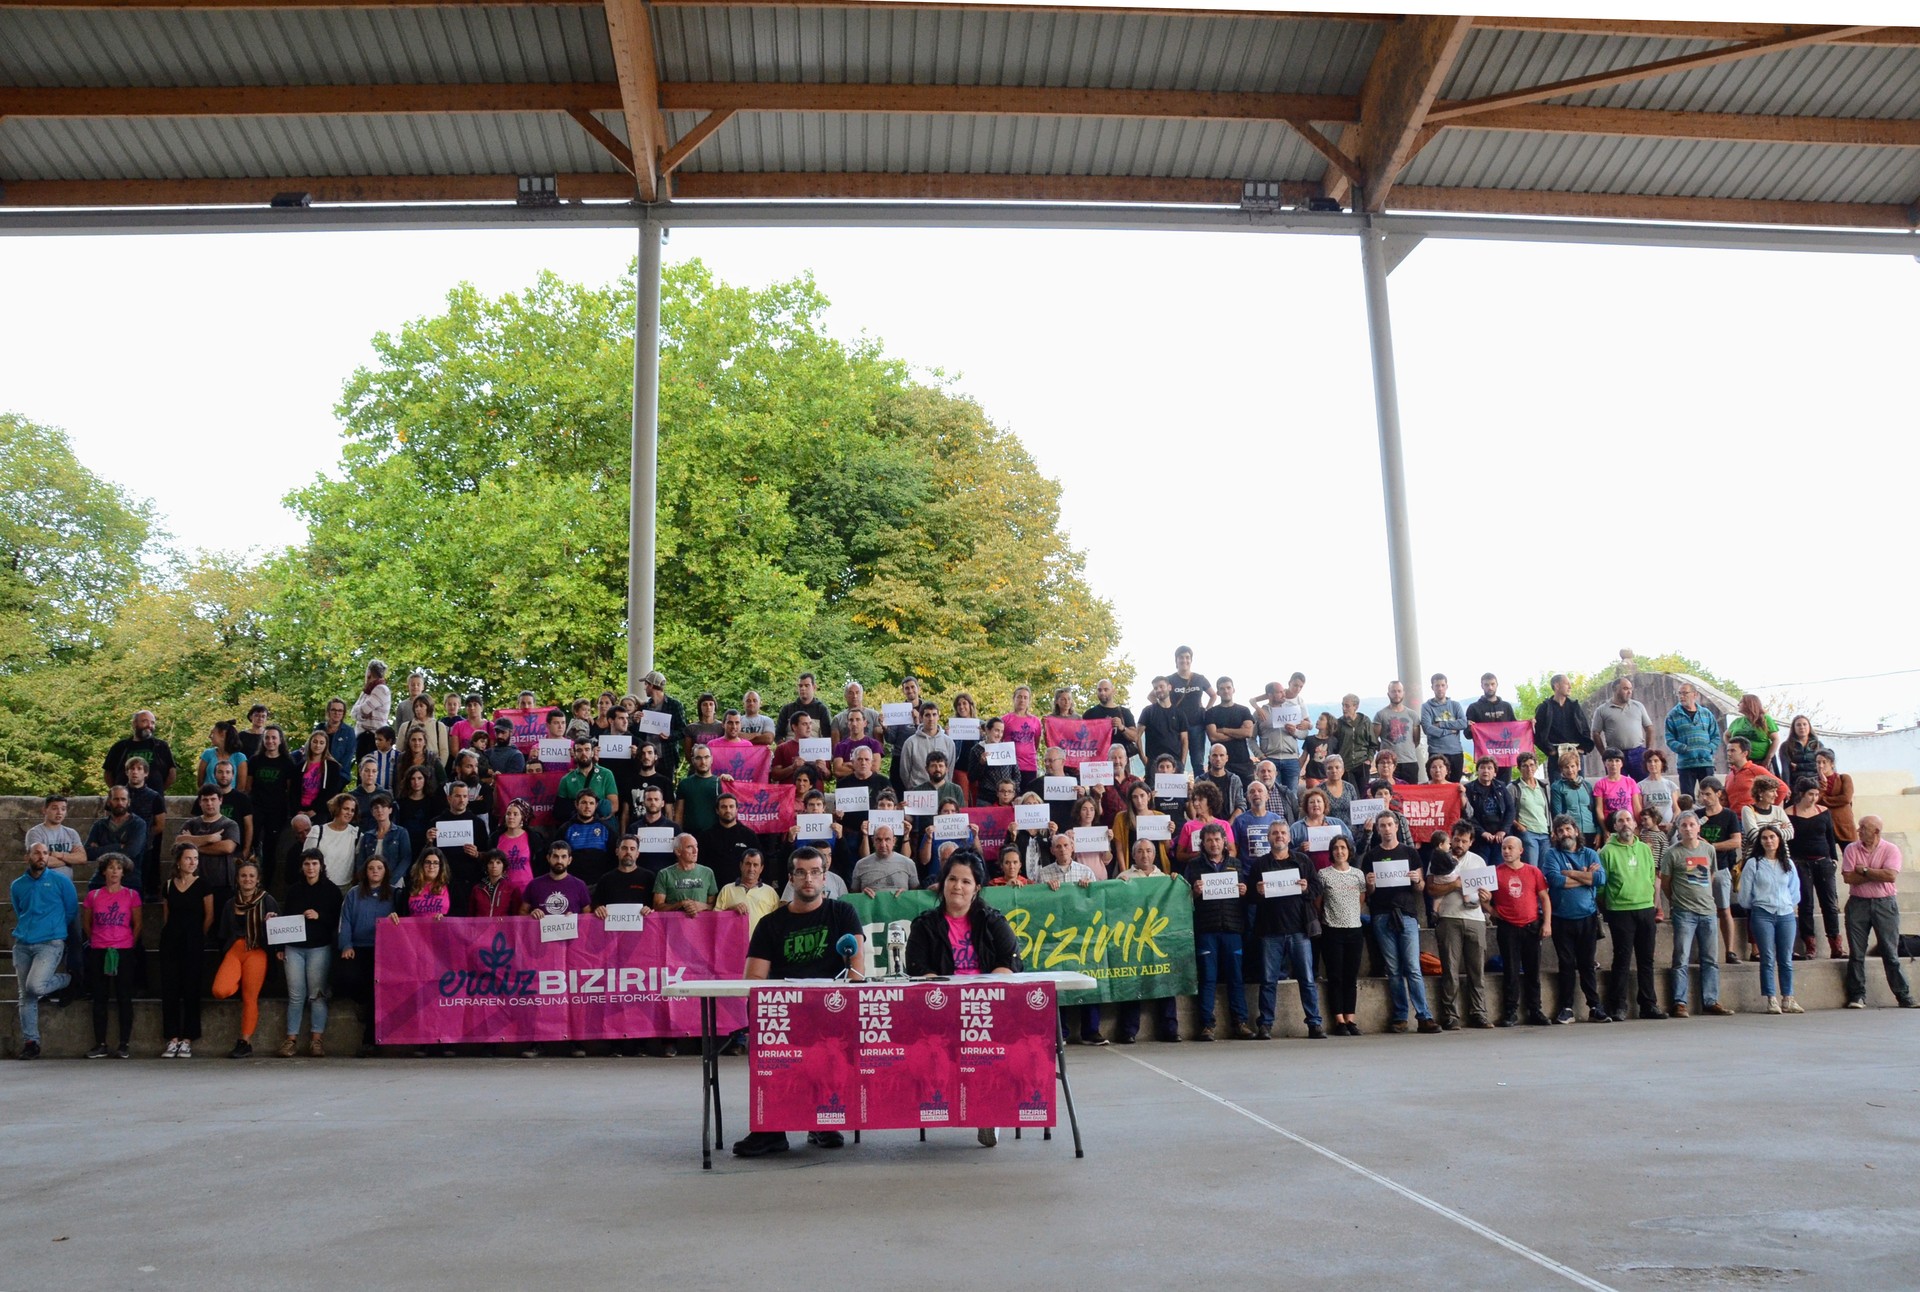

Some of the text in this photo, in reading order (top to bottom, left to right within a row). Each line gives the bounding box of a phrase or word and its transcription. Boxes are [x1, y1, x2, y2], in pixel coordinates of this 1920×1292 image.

[1277, 713, 1298, 723] ANIZ
[541, 748, 568, 756] ERNAI
[606, 744, 623, 753] LAB
[1067, 749, 1097, 757] IZIRIK
[990, 750, 1011, 760] ZIGA
[837, 796, 867, 804] ARRAIOZ
[906, 795, 935, 808] EHNE
[737, 812, 779, 822] BIZIRIK
[805, 823, 824, 832] BRT
[439, 831, 471, 839] ARIZKUN
[1376, 870, 1408, 879] LEKAROZ
[1206, 877, 1234, 887] ORONOZ
[1464, 875, 1495, 888] SORTU
[1204, 887, 1237, 896] MUGAIRE
[607, 914, 641, 922] IRURITA
[270, 926, 302, 935] IÑARROSI
[542, 922, 575, 933] ERRATZU
[783, 929, 829, 957] ERDIZ
[439, 952, 687, 998] erdiz BIZIRIK
[1141, 963, 1171, 976] ALDE
[758, 991, 803, 1003] MANI
[859, 989, 904, 1002] MANI
[960, 989, 1005, 1000] MANI
[439, 997, 506, 1007] LURRAREN
[509, 996, 569, 1006] OSASUNA
[572, 994, 606, 1004] GURE
[758, 1005, 789, 1017] FES
[860, 1003, 890, 1015] FES
[961, 1002, 991, 1014] FES
[757, 1019, 791, 1031] TAZ
[859, 1017, 892, 1029] TAZ
[960, 1016, 993, 1028] TAZ
[758, 1032, 789, 1045] IOA
[860, 1030, 891, 1043] IOA
[961, 1029, 991, 1042] IOA
[758, 1050, 792, 1058] URRIAK
[960, 1047, 994, 1055] URRIAK
